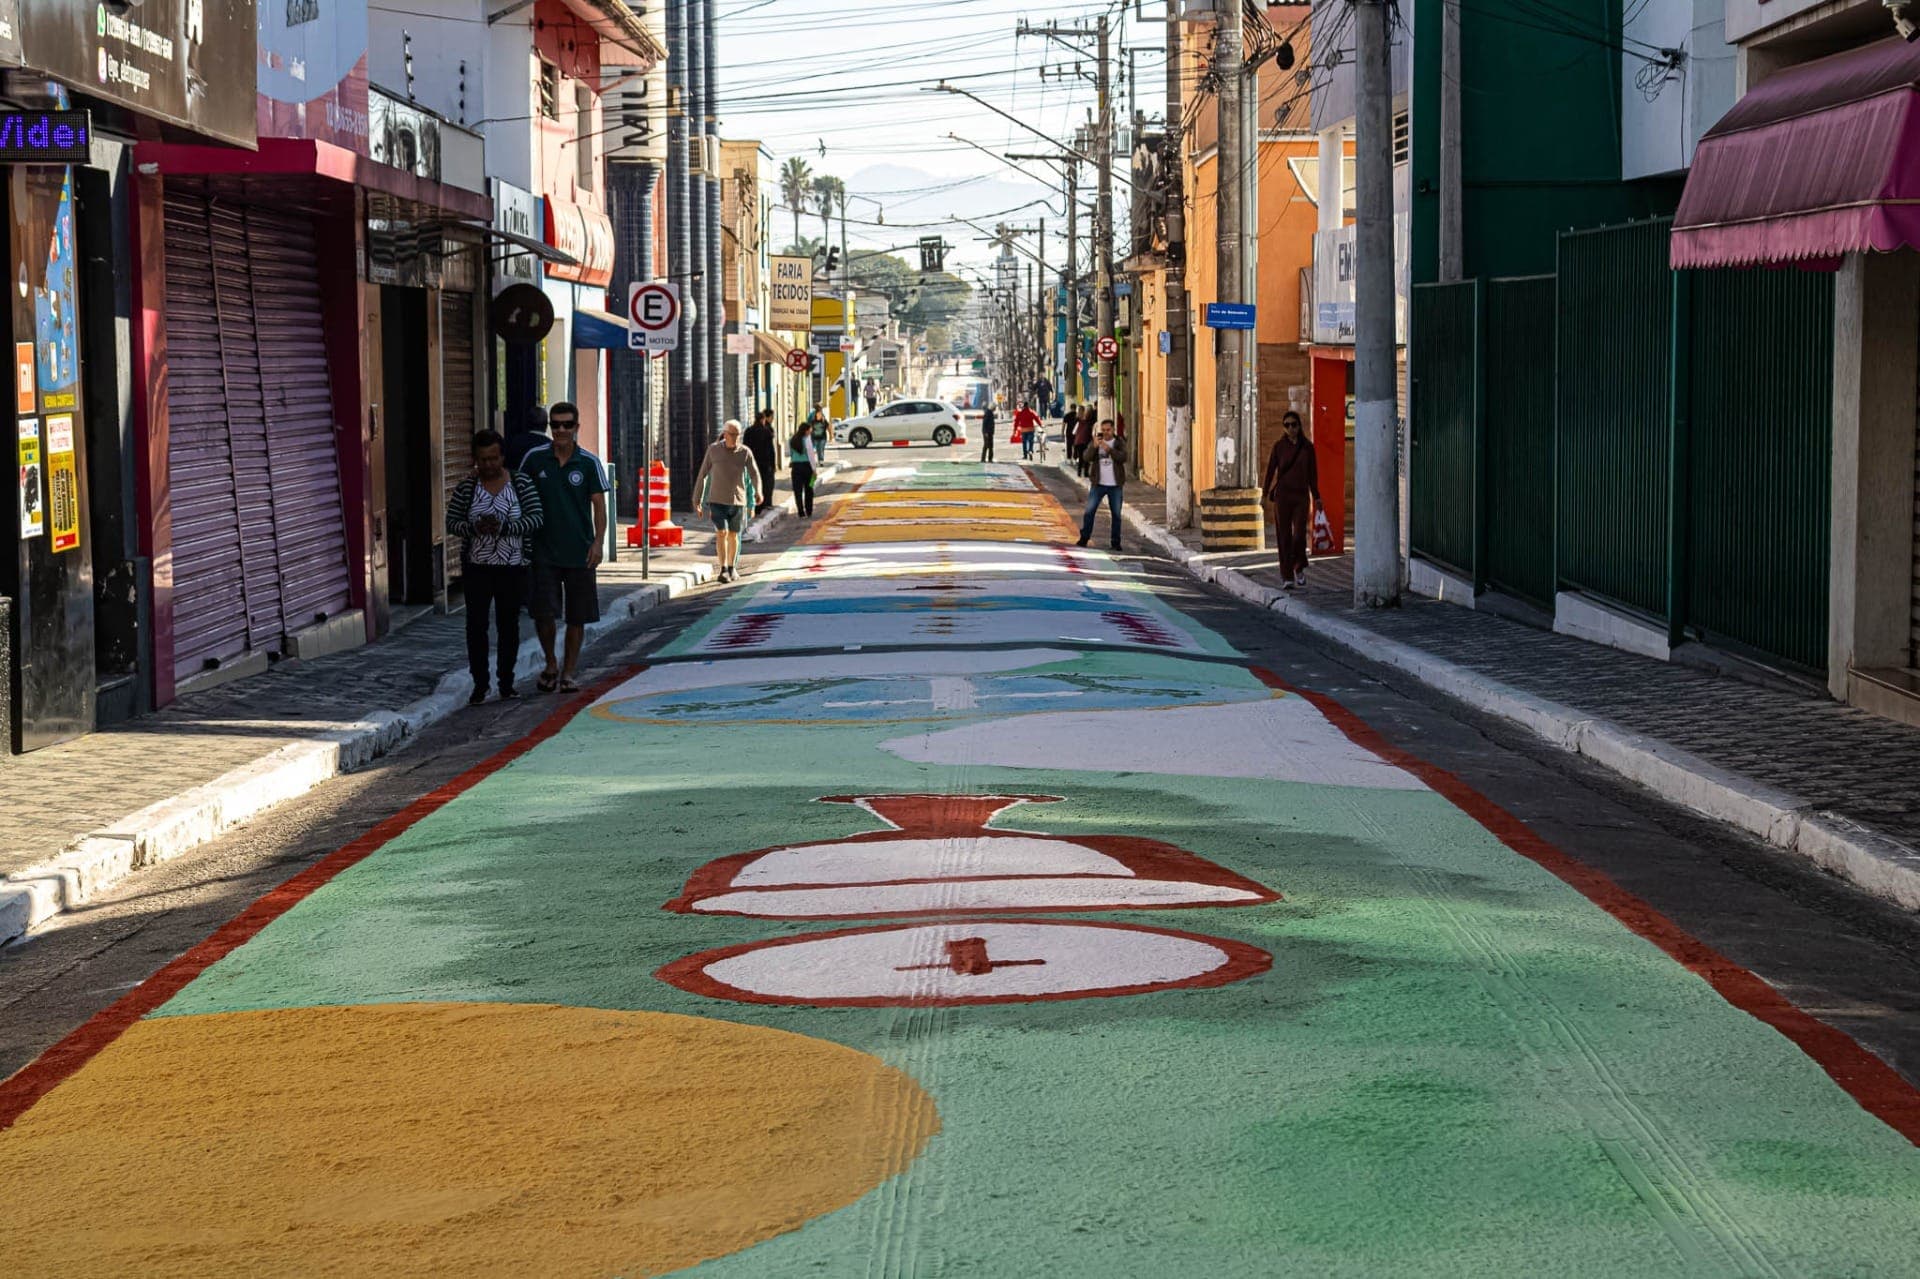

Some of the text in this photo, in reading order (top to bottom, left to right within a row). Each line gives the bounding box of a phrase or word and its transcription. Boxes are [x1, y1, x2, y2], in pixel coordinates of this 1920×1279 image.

[777, 263, 803, 280] FARIA
[772, 284, 809, 301] TECIDOS
[644, 294, 663, 321] E
[649, 337, 675, 345] MOTOS
